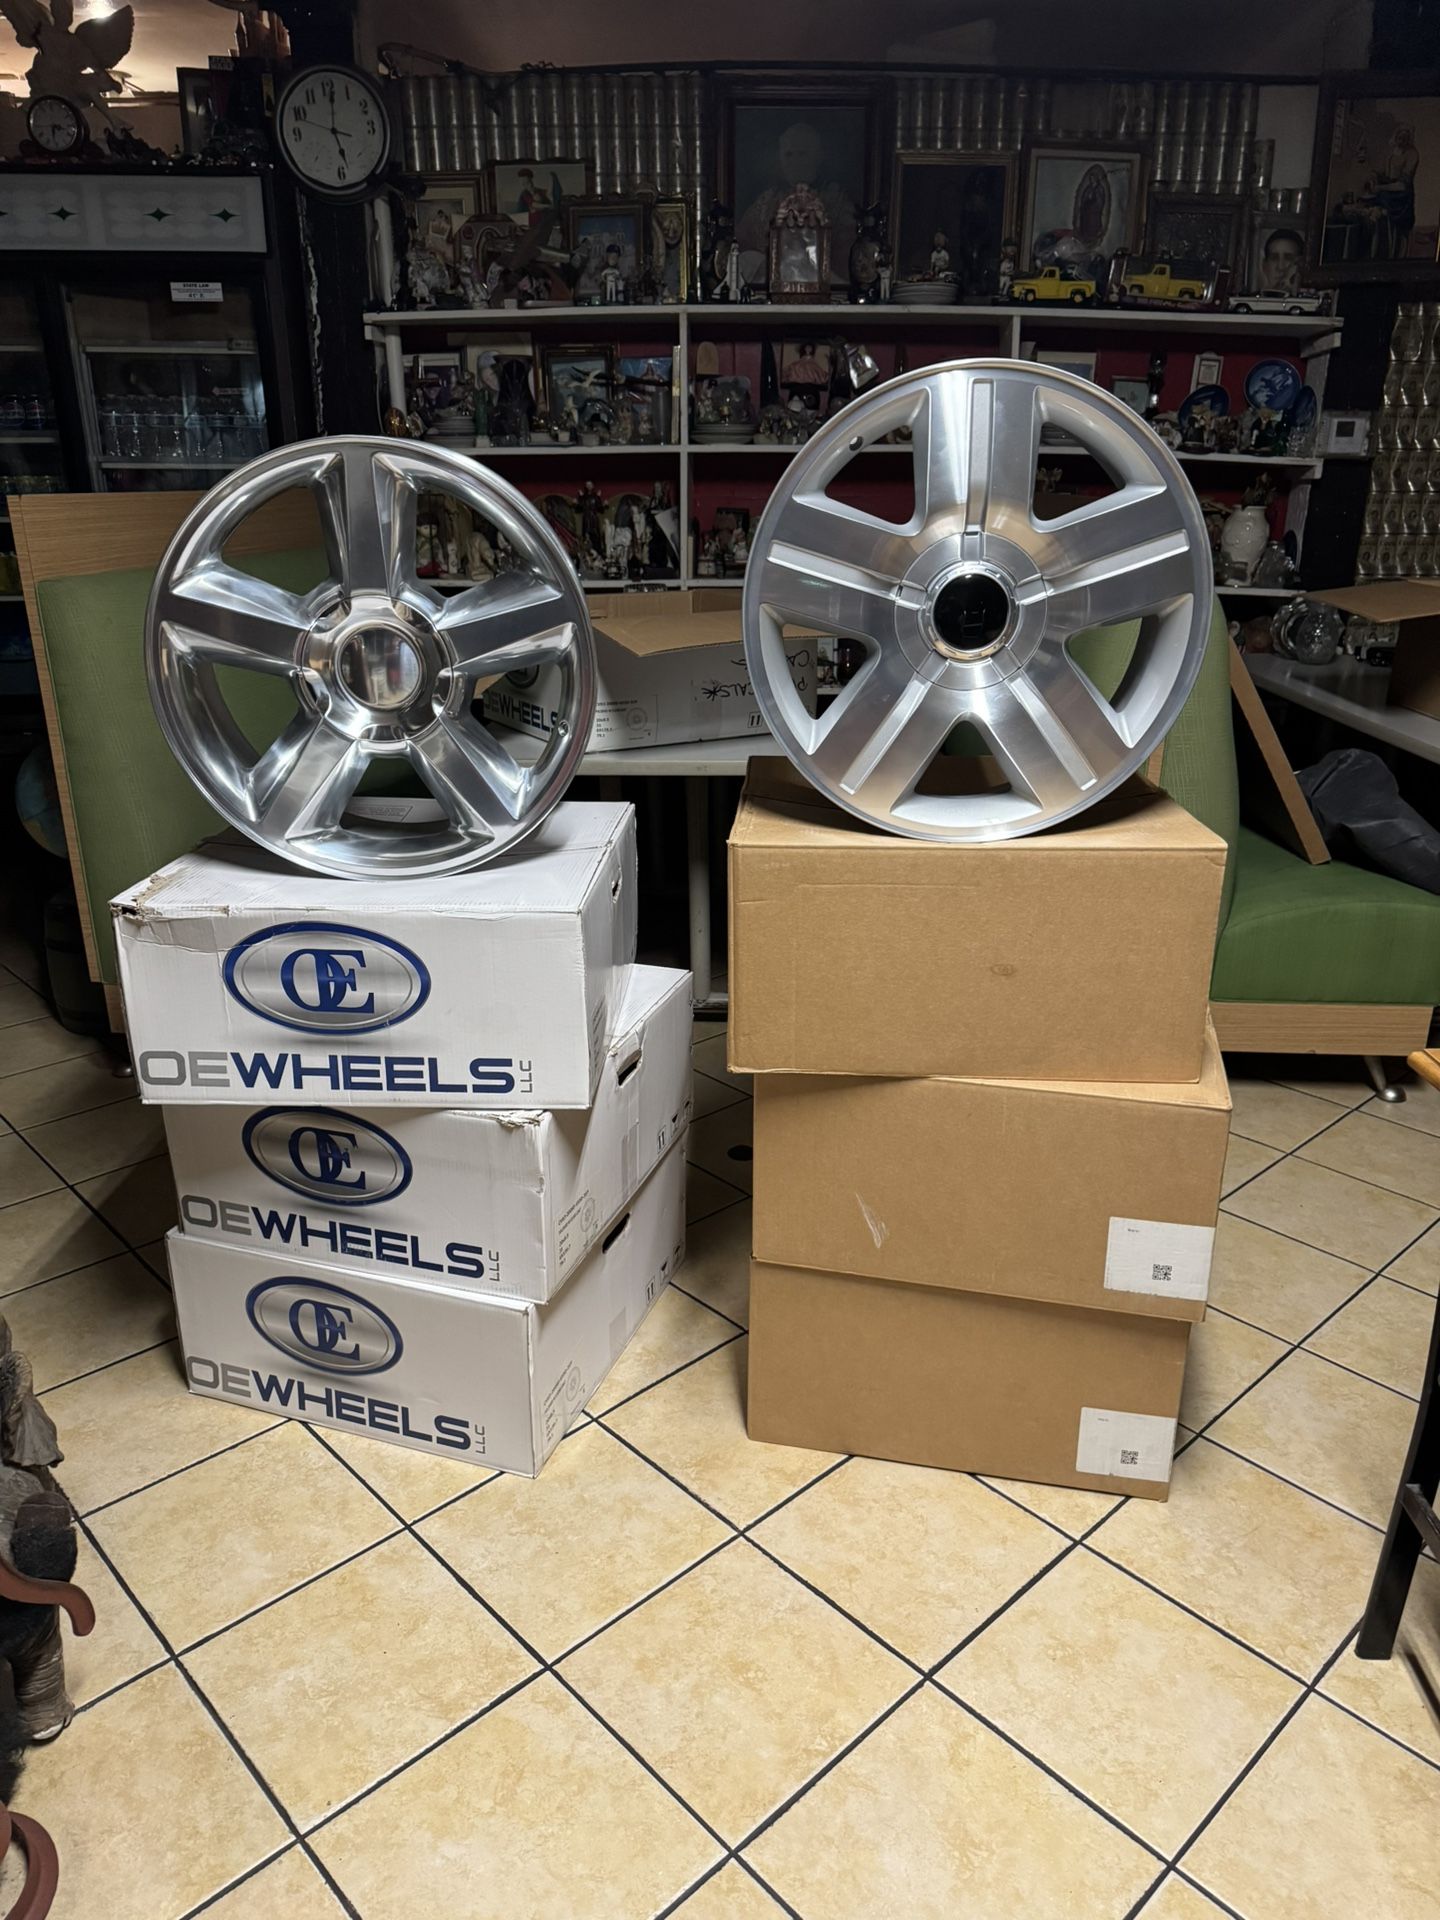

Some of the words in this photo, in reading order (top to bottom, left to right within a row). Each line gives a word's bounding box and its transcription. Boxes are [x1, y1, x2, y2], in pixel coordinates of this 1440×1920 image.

[305, 87, 316, 105] 11
[293, 105, 307, 121] 10
[359, 99, 369, 115] 2
[292, 126, 302, 143] 9
[367, 119, 376, 136] 3
[337, 166, 347, 182] 6
[518, 1059, 533, 1094] LLC
[489, 1250, 500, 1282] LLC
[475, 1423, 486, 1454] LLC
